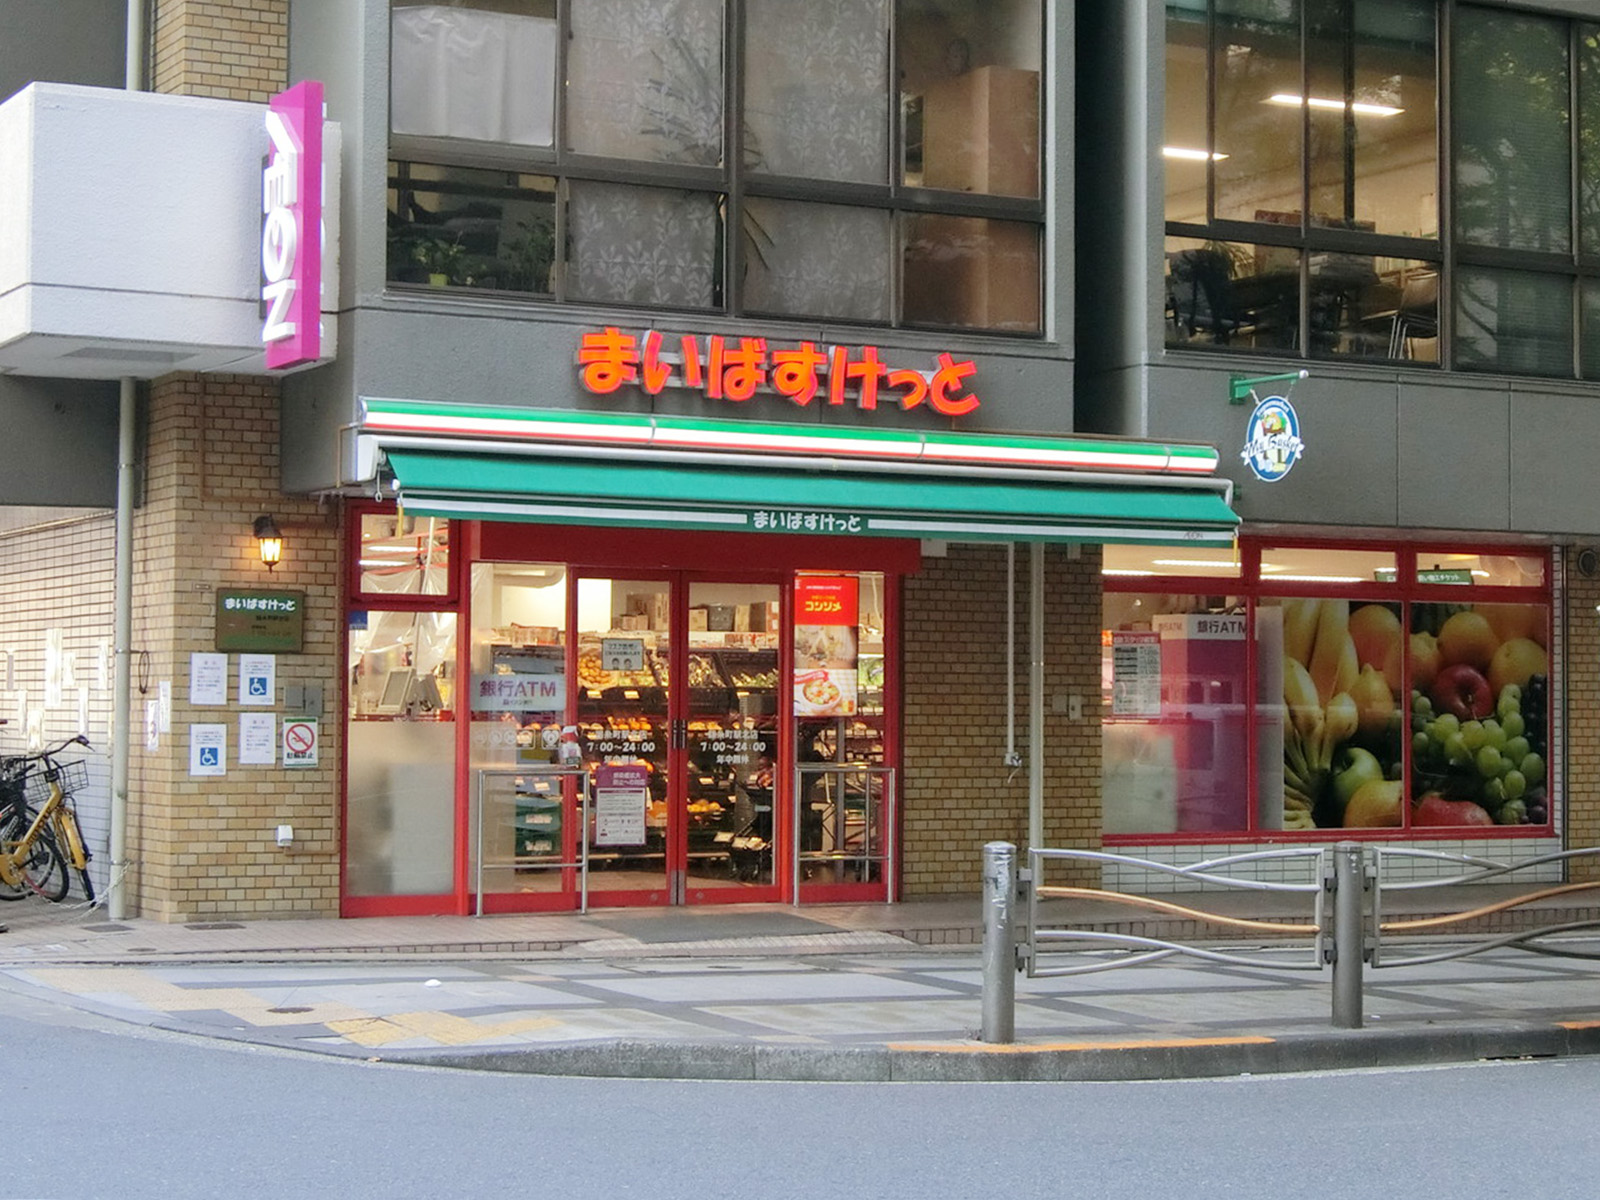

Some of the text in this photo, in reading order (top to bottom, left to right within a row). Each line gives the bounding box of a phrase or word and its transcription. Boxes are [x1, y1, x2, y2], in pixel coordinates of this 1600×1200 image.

[577, 326, 981, 416] まいばすけっと
[753, 510, 862, 533] まいばすけっと
[224, 597, 296, 612] まいばすけっと
[805, 601, 842, 612] コンソメ
[480, 680, 556, 697] 銀行ATM
